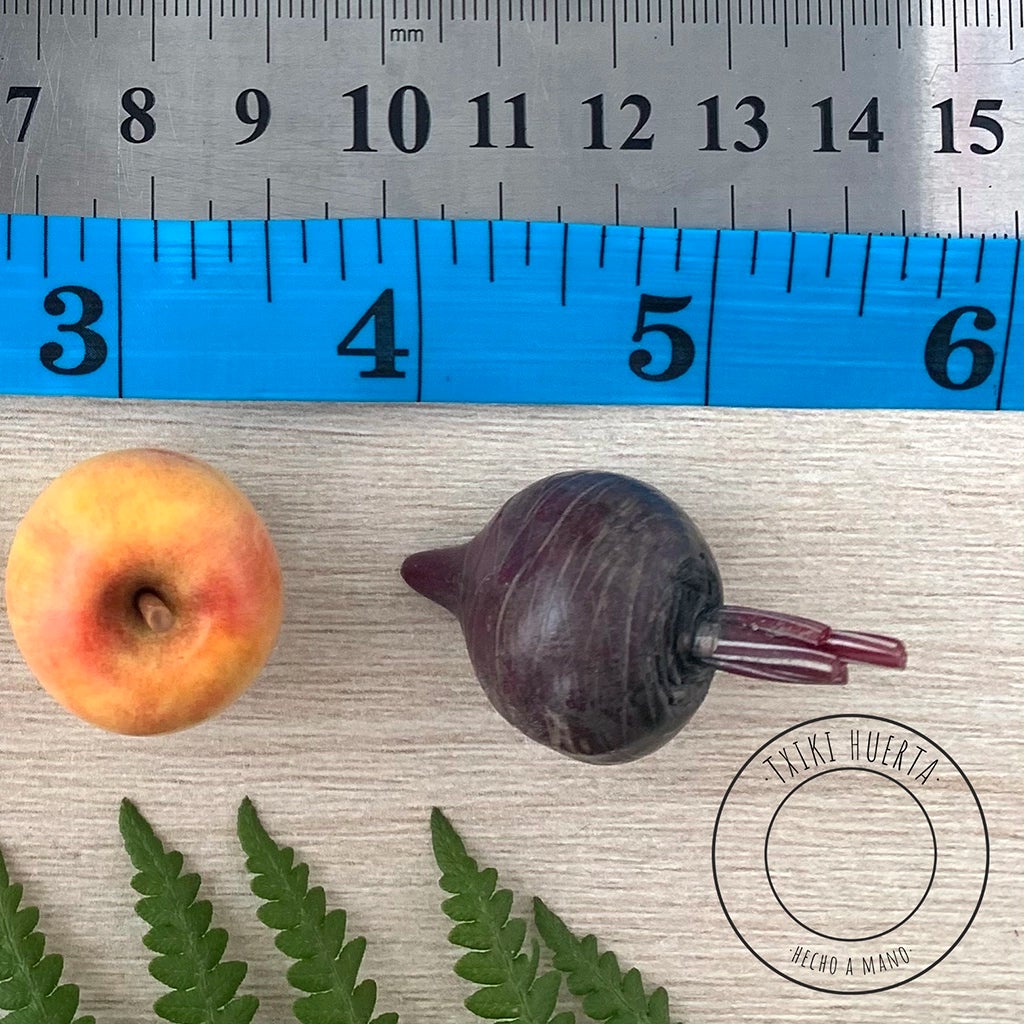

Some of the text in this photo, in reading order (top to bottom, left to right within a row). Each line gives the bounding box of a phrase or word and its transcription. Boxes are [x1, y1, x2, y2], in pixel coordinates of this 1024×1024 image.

[390, 27, 425, 42] mm
[6, 86, 43, 143] 7
[120, 87, 157, 144] 8
[235, 88, 272, 145] 9
[342, 84, 432, 155] 10
[468, 92, 535, 149] 11
[581, 93, 656, 151] 12
[697, 95, 770, 153] 13
[812, 97, 885, 154] 14
[932, 98, 1005, 156] 15
[39, 285, 109, 376] 3
[336, 287, 410, 379] 4
[628, 293, 696, 383] 5
[923, 305, 997, 391] 6
